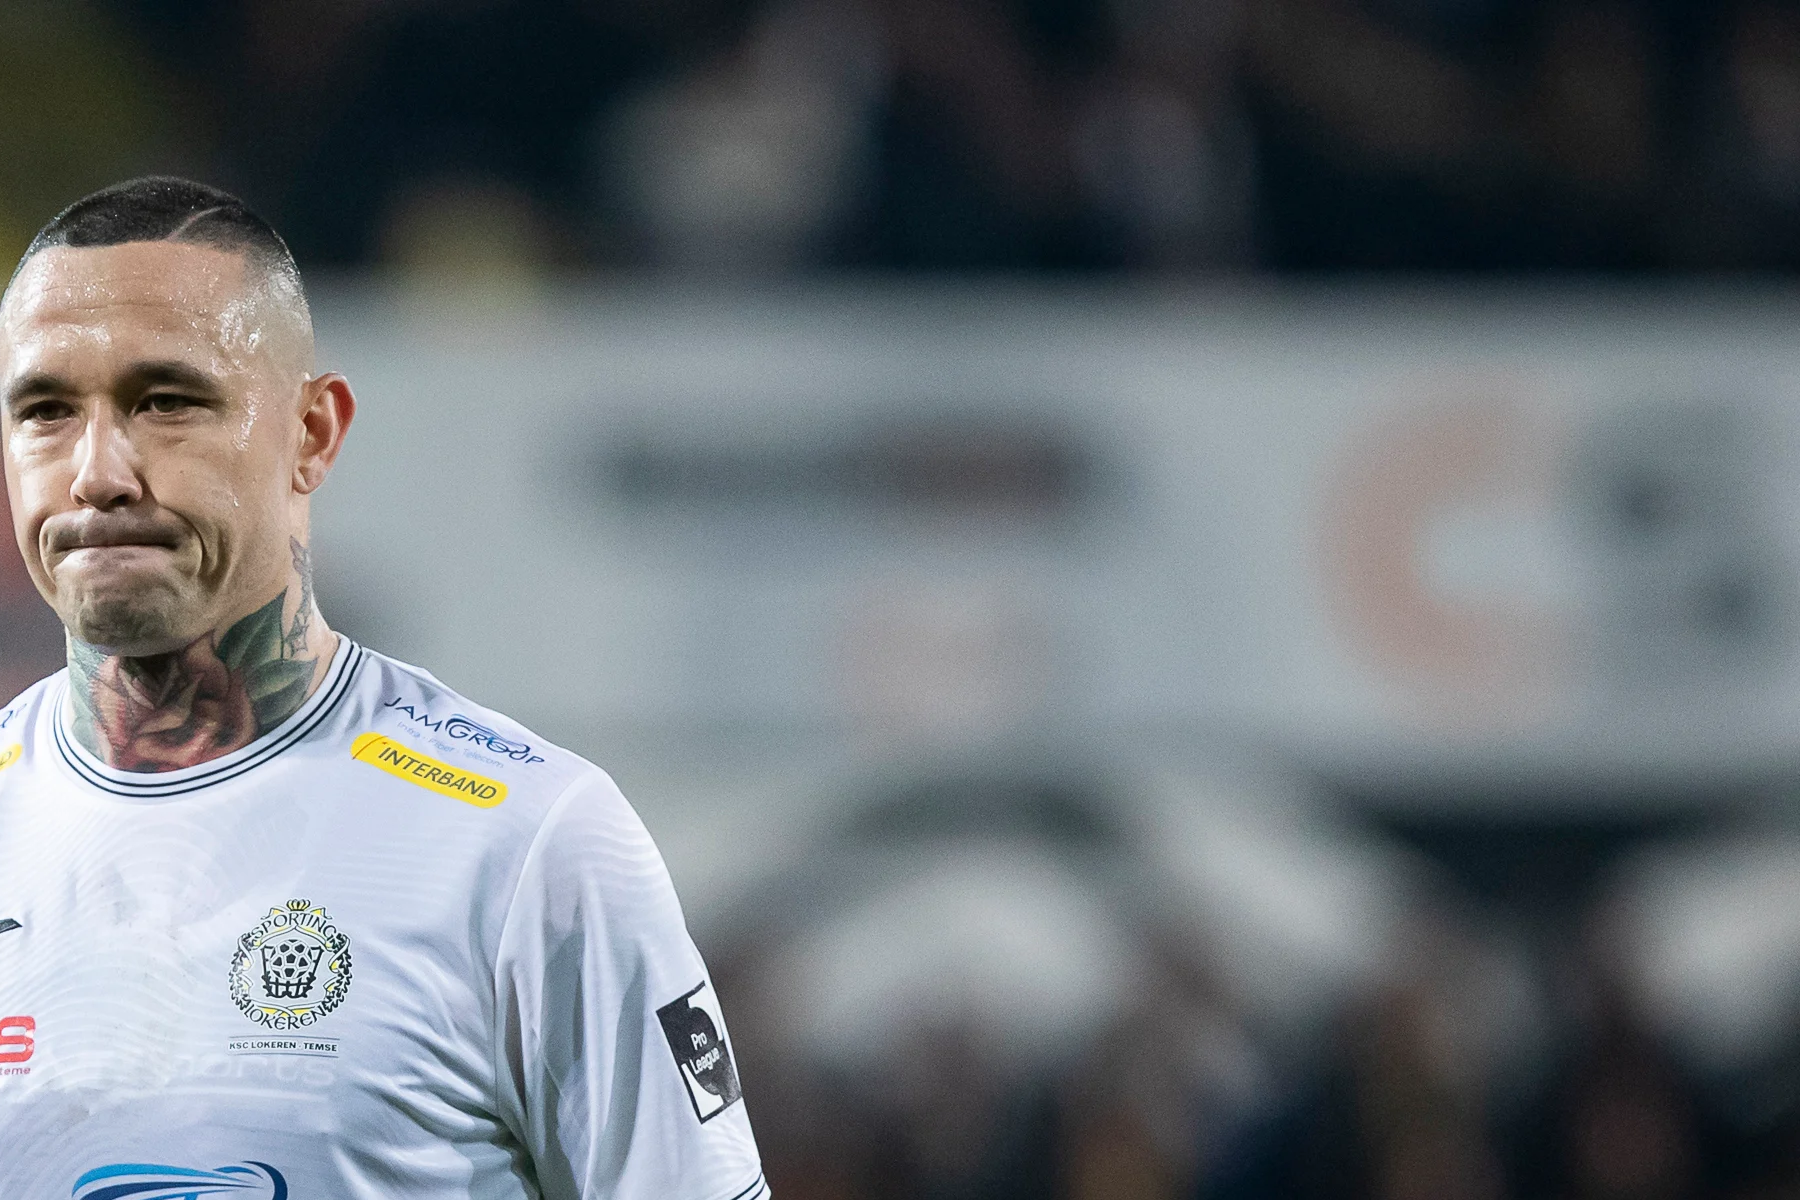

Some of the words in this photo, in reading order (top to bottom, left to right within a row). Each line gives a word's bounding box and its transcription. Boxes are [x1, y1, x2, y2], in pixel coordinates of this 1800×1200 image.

[384, 697, 443, 732] JAM
[447, 722, 545, 766] GROUP
[378, 746, 497, 800] INTERBAND
[251, 912, 338, 943] SPORTING
[244, 1002, 328, 1031] LOKEREN
[229, 1041, 249, 1050] KSC
[251, 1041, 297, 1050] LOKEREN
[303, 1042, 338, 1052] TEMSE
[690, 1032, 708, 1051] Pro
[689, 1047, 720, 1075] League
